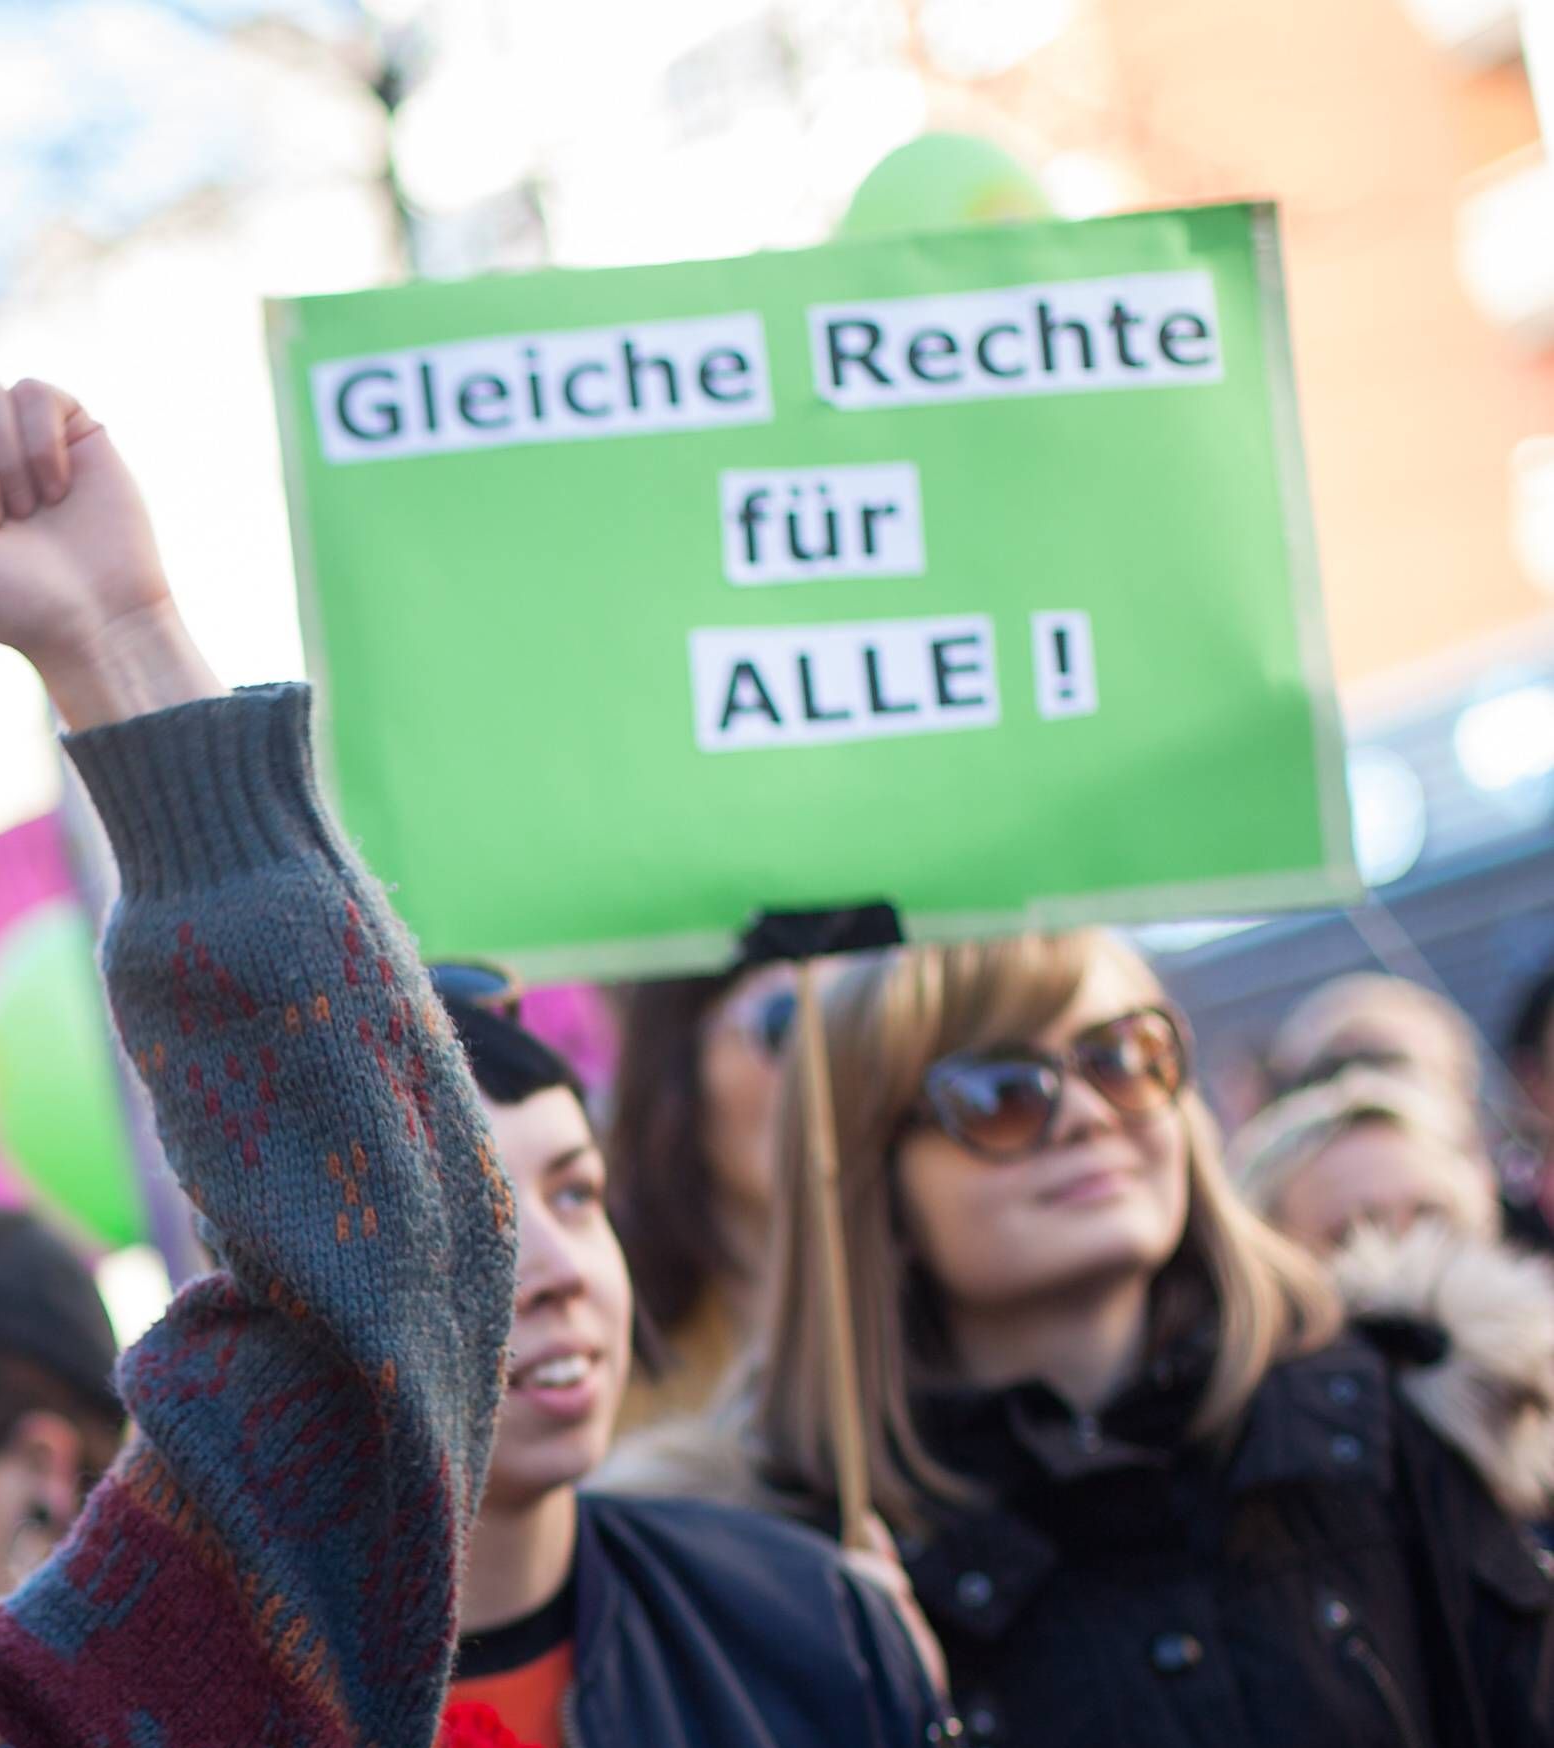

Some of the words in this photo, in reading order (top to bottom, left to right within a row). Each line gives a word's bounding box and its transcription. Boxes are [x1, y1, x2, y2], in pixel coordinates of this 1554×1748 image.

[333, 338, 755, 443] Gleiche
[824, 299, 1212, 389] Rechte
[736, 484, 899, 567] für
[717, 632, 989, 731] ALLE
[1051, 625, 1076, 699] !
